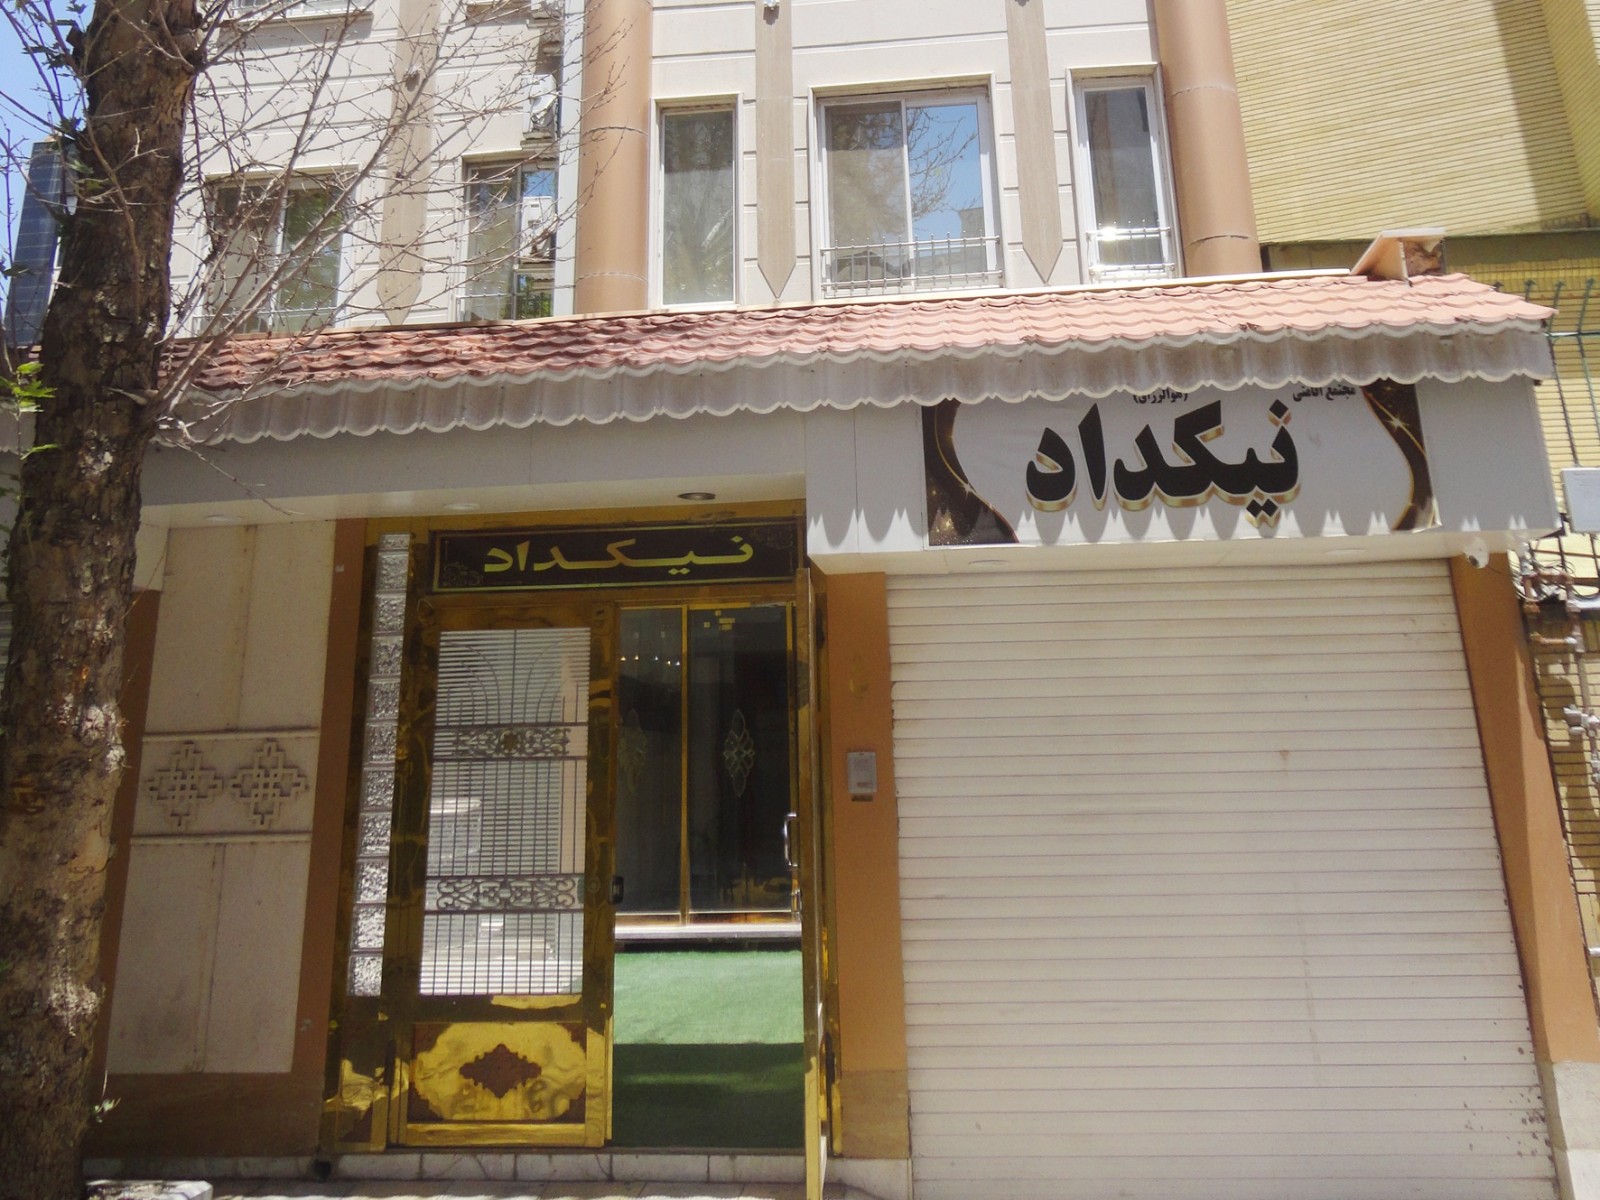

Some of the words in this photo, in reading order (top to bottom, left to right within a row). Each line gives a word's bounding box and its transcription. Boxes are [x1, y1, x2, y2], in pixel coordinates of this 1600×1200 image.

[1325, 384, 1356, 401] مجتمع
[1026, 399, 1300, 527] نیکداد
[484, 535, 754, 575] نیکداد
